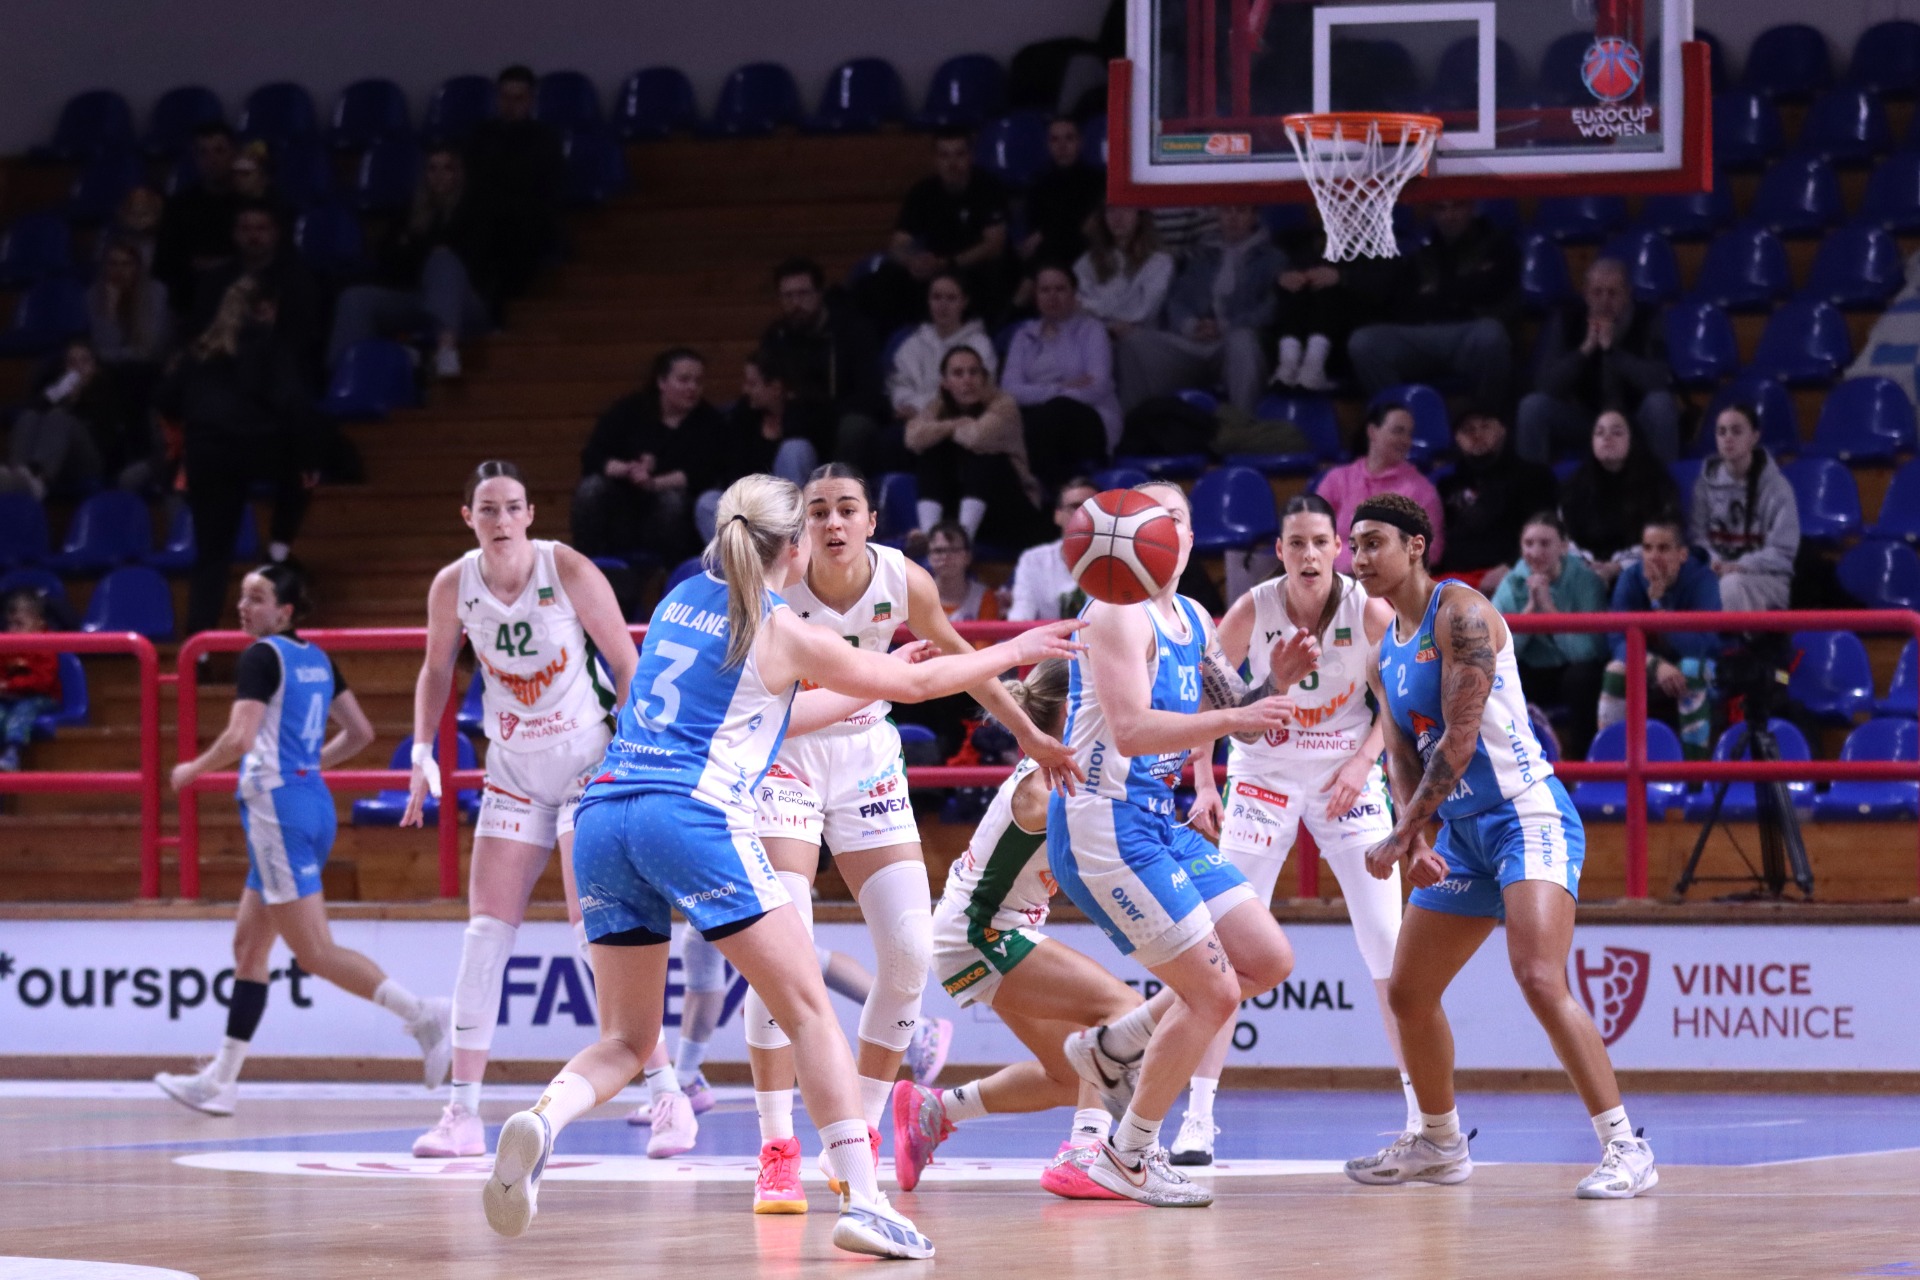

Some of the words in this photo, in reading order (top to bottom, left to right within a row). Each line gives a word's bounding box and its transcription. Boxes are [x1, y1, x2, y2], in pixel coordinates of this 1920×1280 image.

[1572, 107, 1653, 124] EUROCUP
[1579, 123, 1646, 137] WOMEN
[661, 601, 729, 638] BULANE
[496, 622, 538, 657] 42
[633, 639, 699, 733] 3
[1178, 665, 1199, 702] 23
[1397, 663, 1408, 698] 2
[301, 692, 324, 754] 4
[1296, 740, 1357, 750] HNANICE
[778, 796, 815, 808] POKORN
[779, 790, 803, 798] AUTO
[859, 797, 910, 818] FAVEX
[750, 841, 776, 882] JAKO
[676, 881, 737, 909] agnecoil
[1112, 886, 1145, 923] JAKO
[944, 966, 986, 994] hance
[1672, 964, 1811, 995] VINICE
[1673, 1006, 1854, 1038] HNANICE
[829, 1137, 865, 1149] JORDAN
